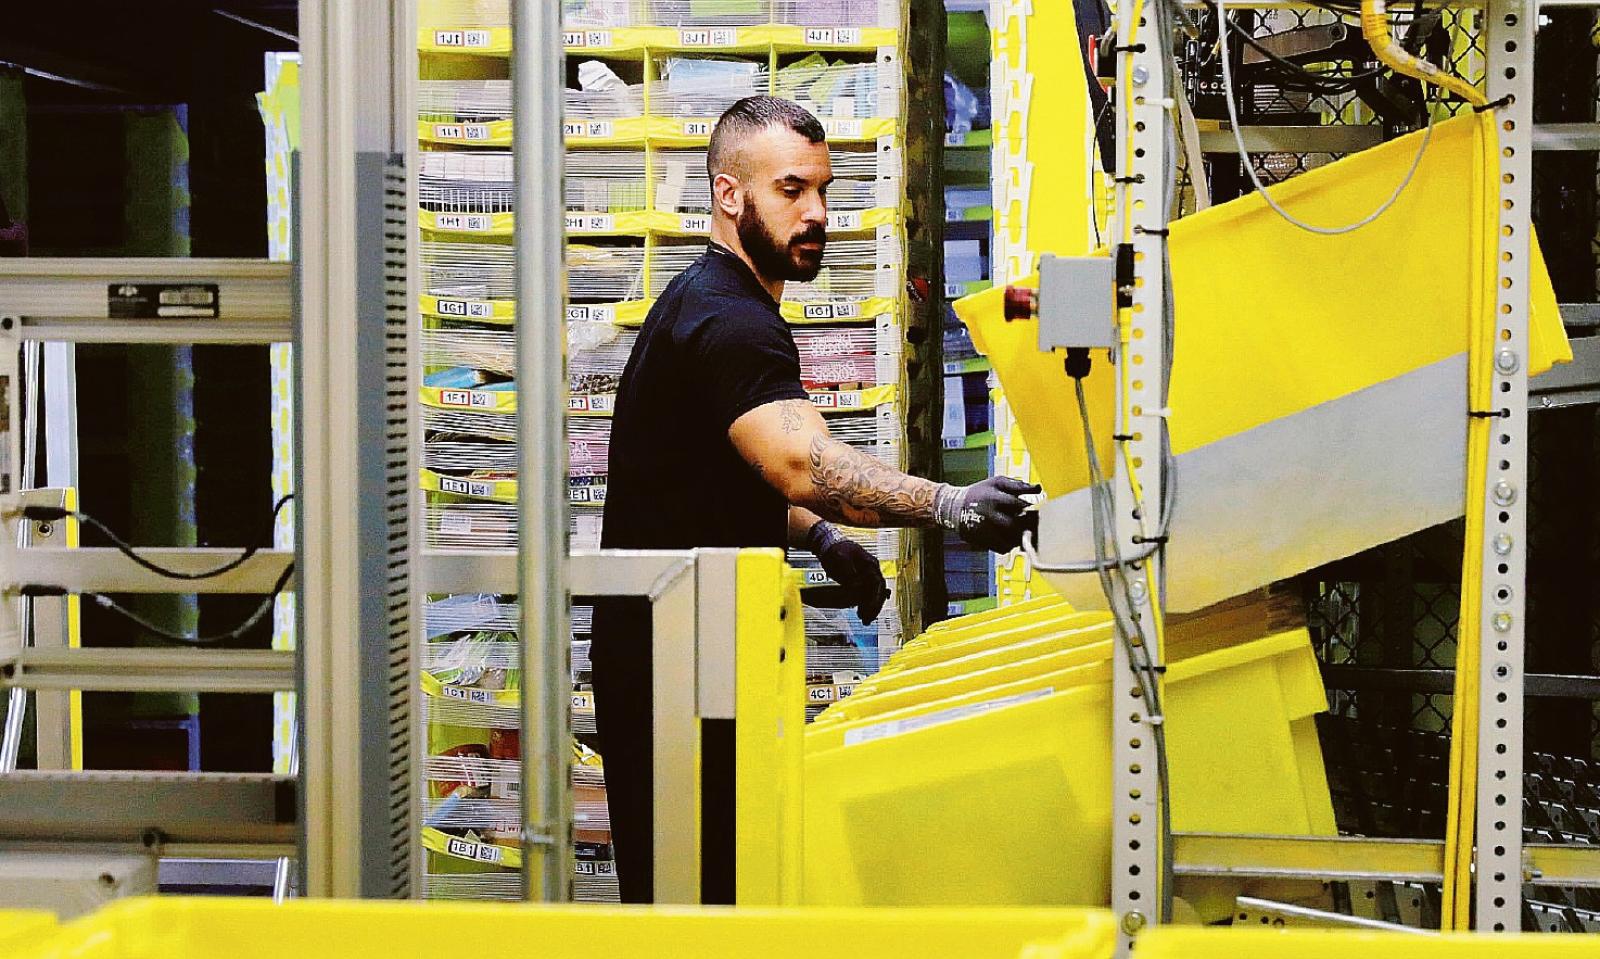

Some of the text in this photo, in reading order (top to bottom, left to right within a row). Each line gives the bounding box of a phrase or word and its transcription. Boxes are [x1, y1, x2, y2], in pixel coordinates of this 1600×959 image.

[440, 34, 453, 44] 1J
[685, 33, 698, 43] 3J
[809, 31, 822, 41] 4J
[688, 124, 698, 134] 3I
[440, 217, 455, 226] 1H
[685, 219, 700, 229] 3H
[444, 303, 457, 313] 1G
[808, 307, 823, 316] 4G
[446, 393, 459, 402] 1F
[812, 395, 826, 404] 4F
[446, 482, 457, 491] 1E
[810, 572, 824, 581] 4D
[444, 687, 457, 697] 1C
[810, 690, 825, 699] 4C
[453, 842, 467, 852] 1B
